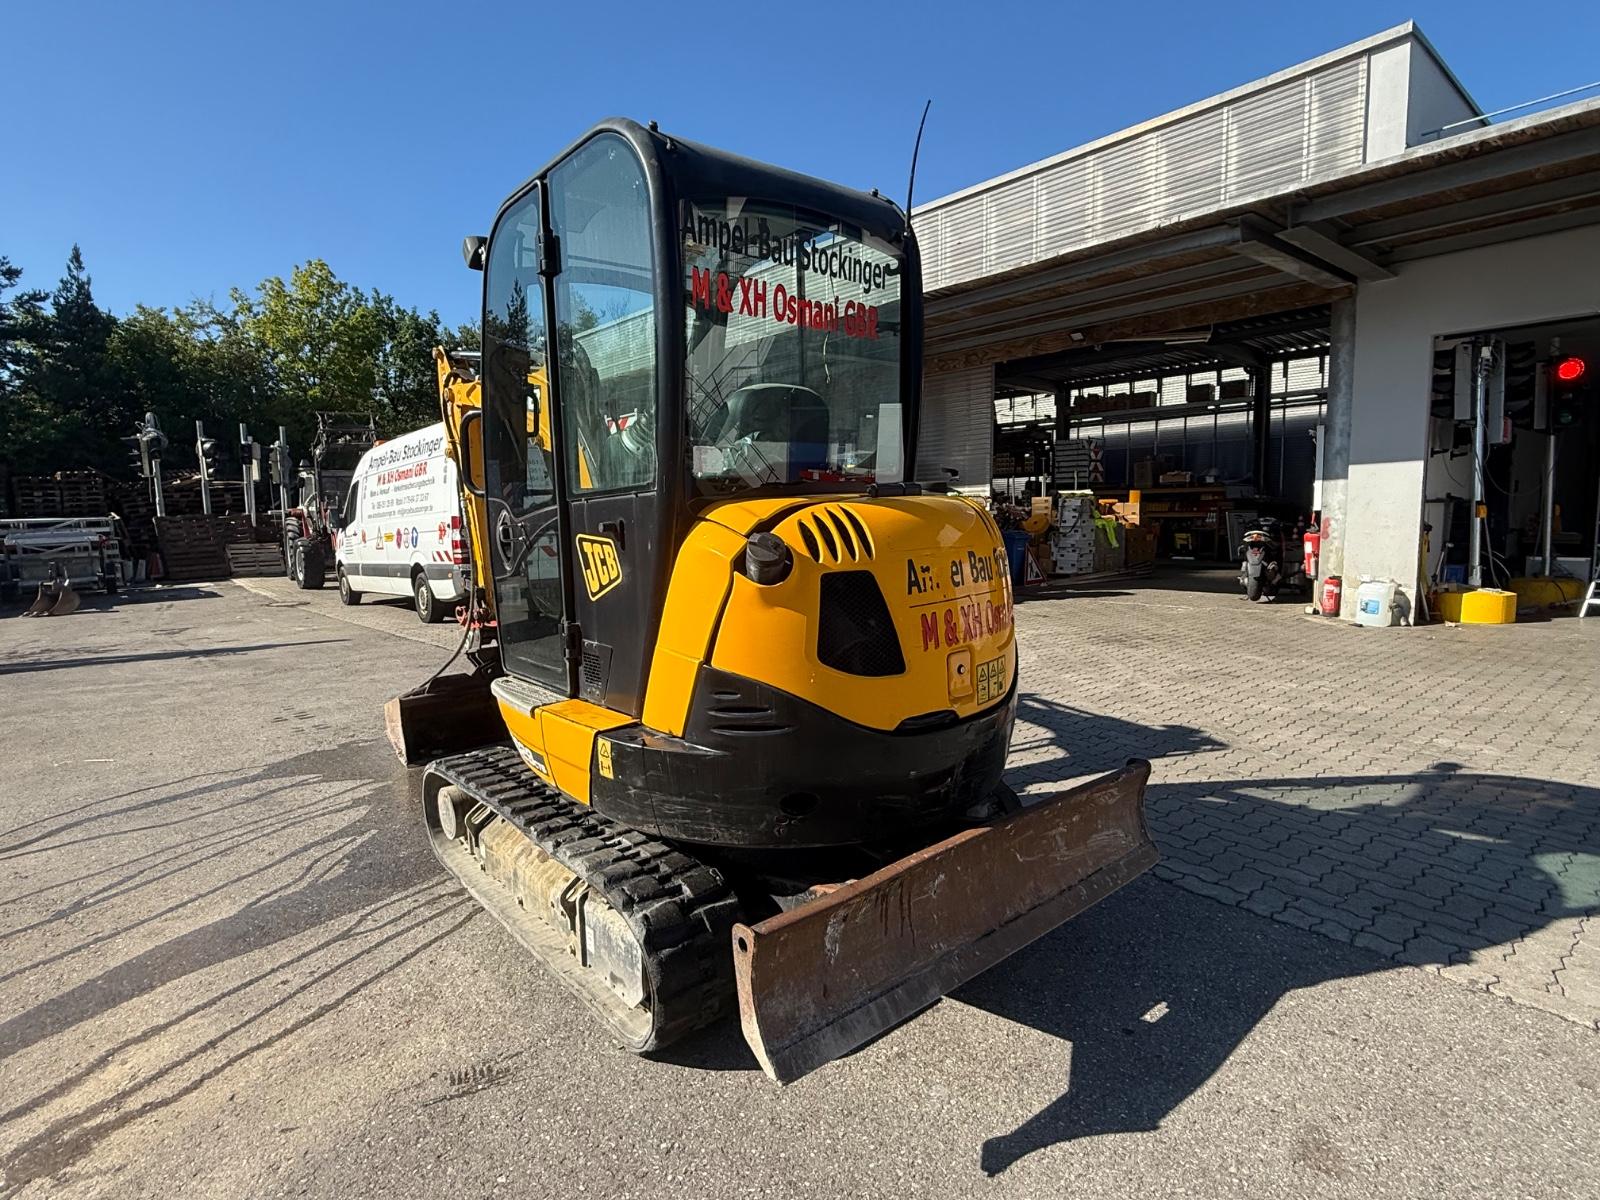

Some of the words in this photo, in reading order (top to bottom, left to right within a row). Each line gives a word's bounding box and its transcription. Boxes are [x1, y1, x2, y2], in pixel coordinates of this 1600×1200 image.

[801, 238, 888, 294] Stockinger
[691, 265, 710, 310] M
[716, 271, 733, 313] &
[738, 276, 767, 318] XH
[773, 283, 839, 332] Osmani
[844, 299, 880, 339] GBR
[402, 437, 443, 460] Stockinger
[582, 541, 619, 593] JCB
[968, 550, 993, 583] Bau
[921, 611, 940, 652] M
[944, 609, 960, 647] &
[960, 601, 983, 643] XH
